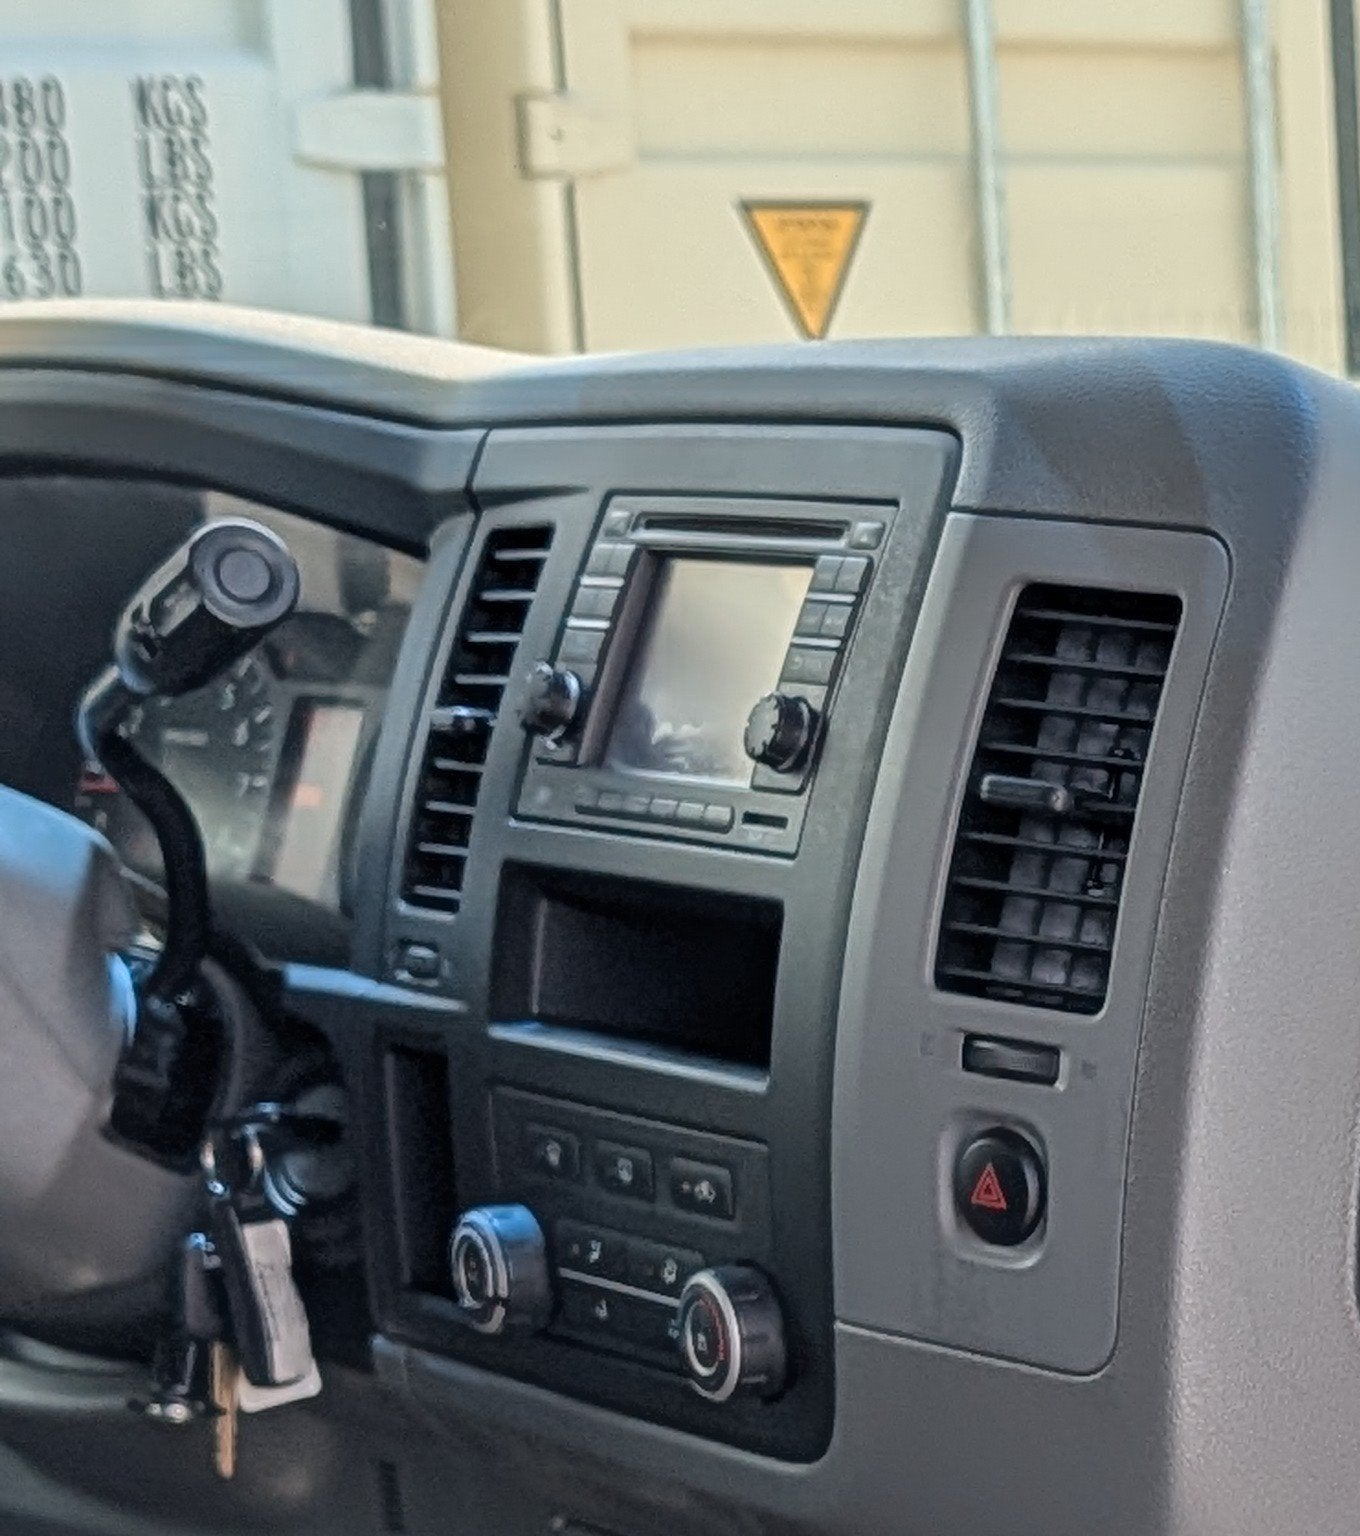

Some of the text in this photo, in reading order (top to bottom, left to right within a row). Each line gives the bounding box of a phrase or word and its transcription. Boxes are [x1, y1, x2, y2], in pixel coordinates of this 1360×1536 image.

[0, 74, 208, 134] 80 KGS
[136, 132, 213, 191] LBS
[143, 190, 218, 247] KGS
[150, 246, 224, 299] LBS
